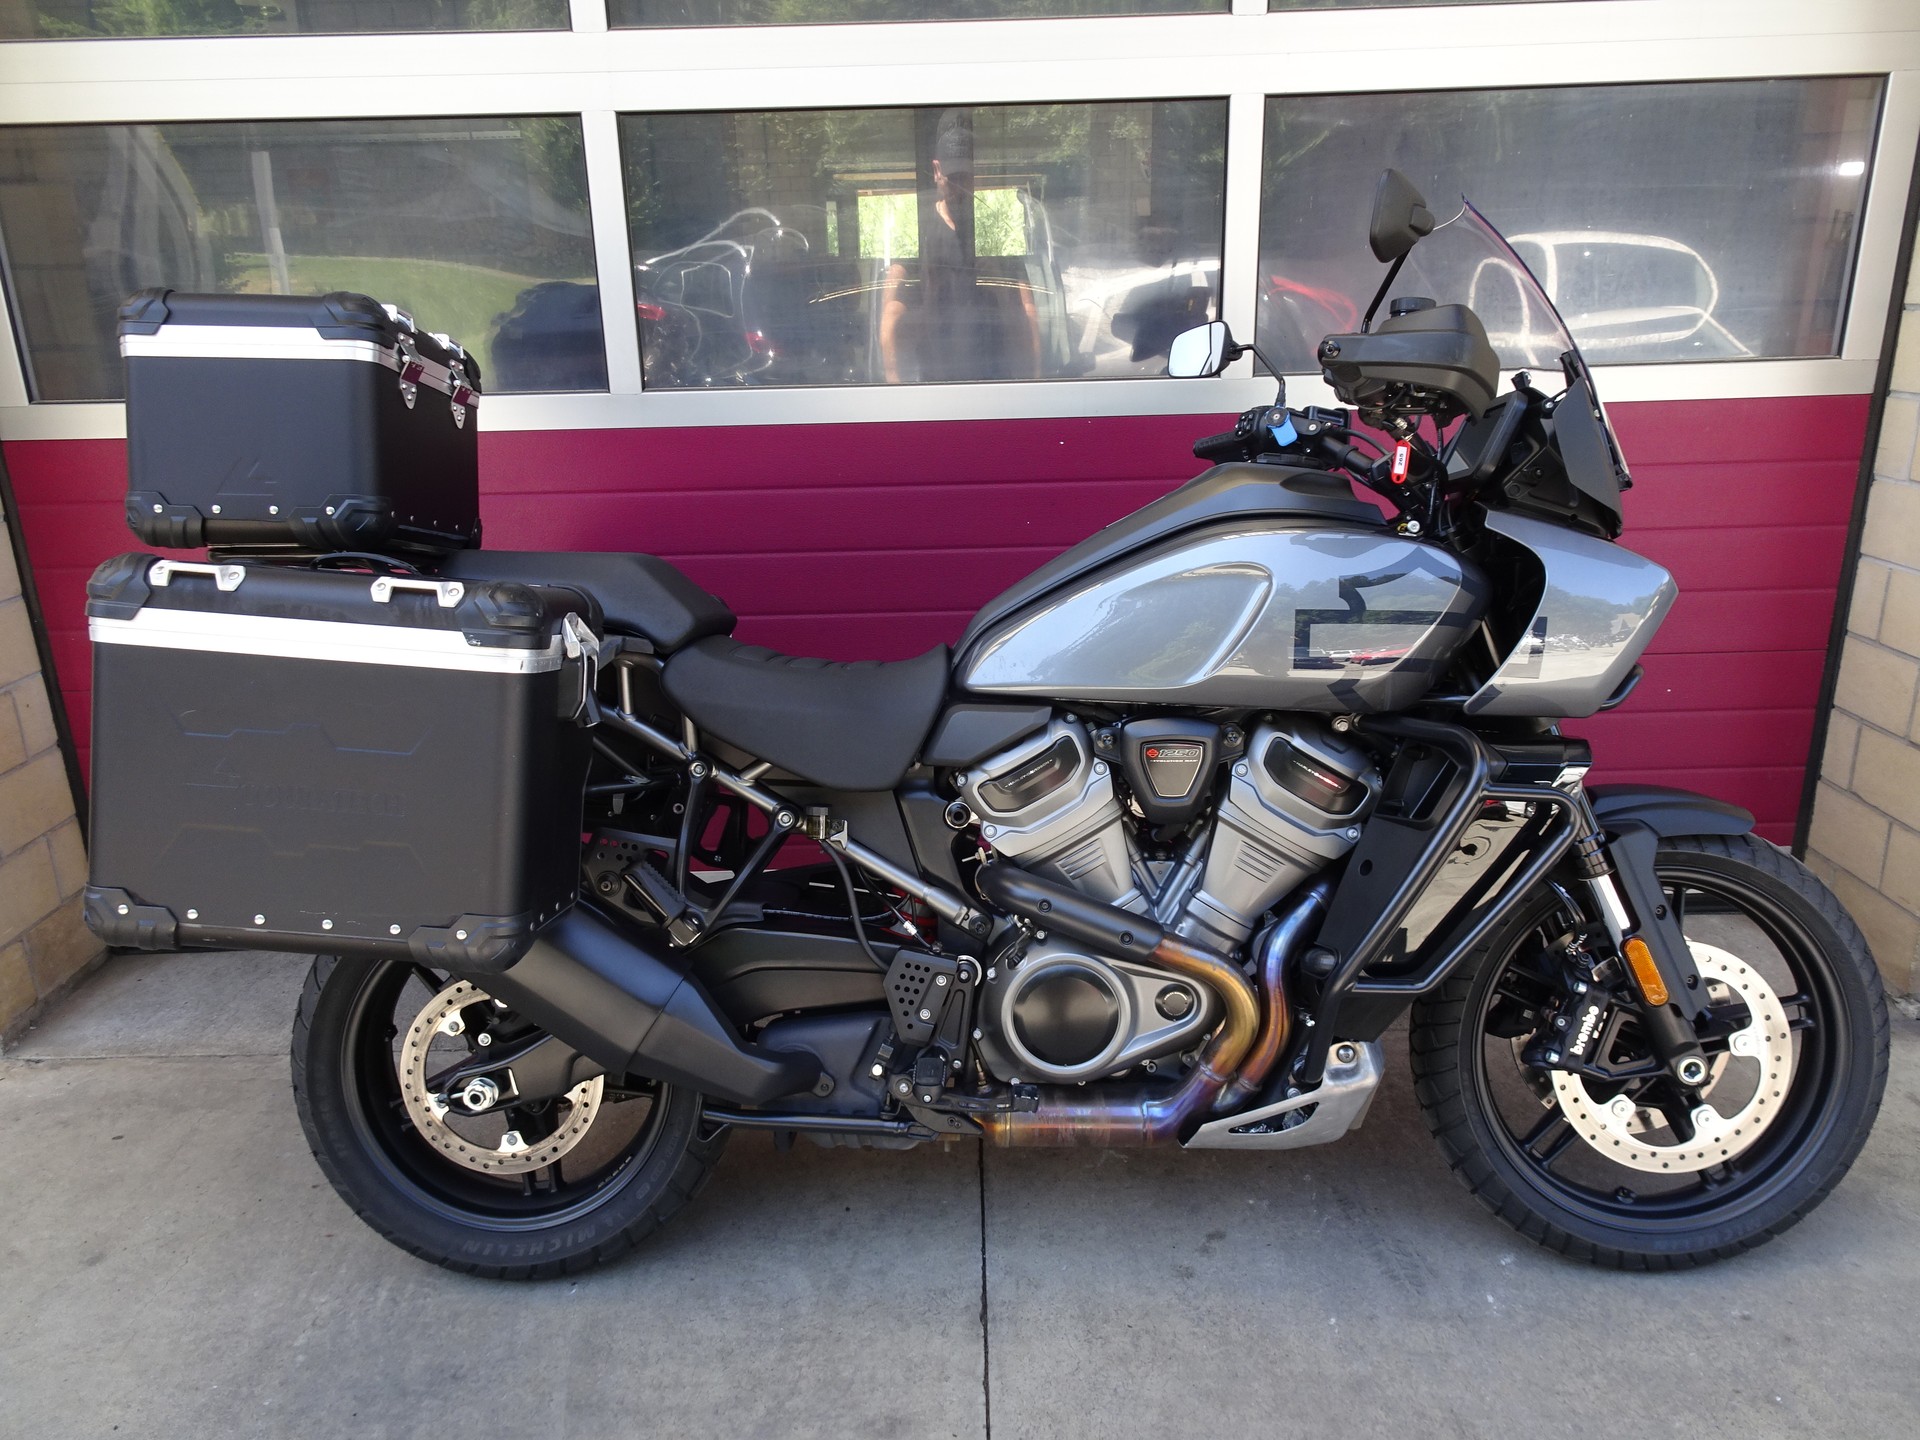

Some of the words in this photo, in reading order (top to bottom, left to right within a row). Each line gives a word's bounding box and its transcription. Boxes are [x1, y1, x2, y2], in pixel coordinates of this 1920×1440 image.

[1158, 748, 1199, 758] 1250
[1569, 1005, 1600, 1056] brembo
[462, 1224, 597, 1257] MICHELIN
